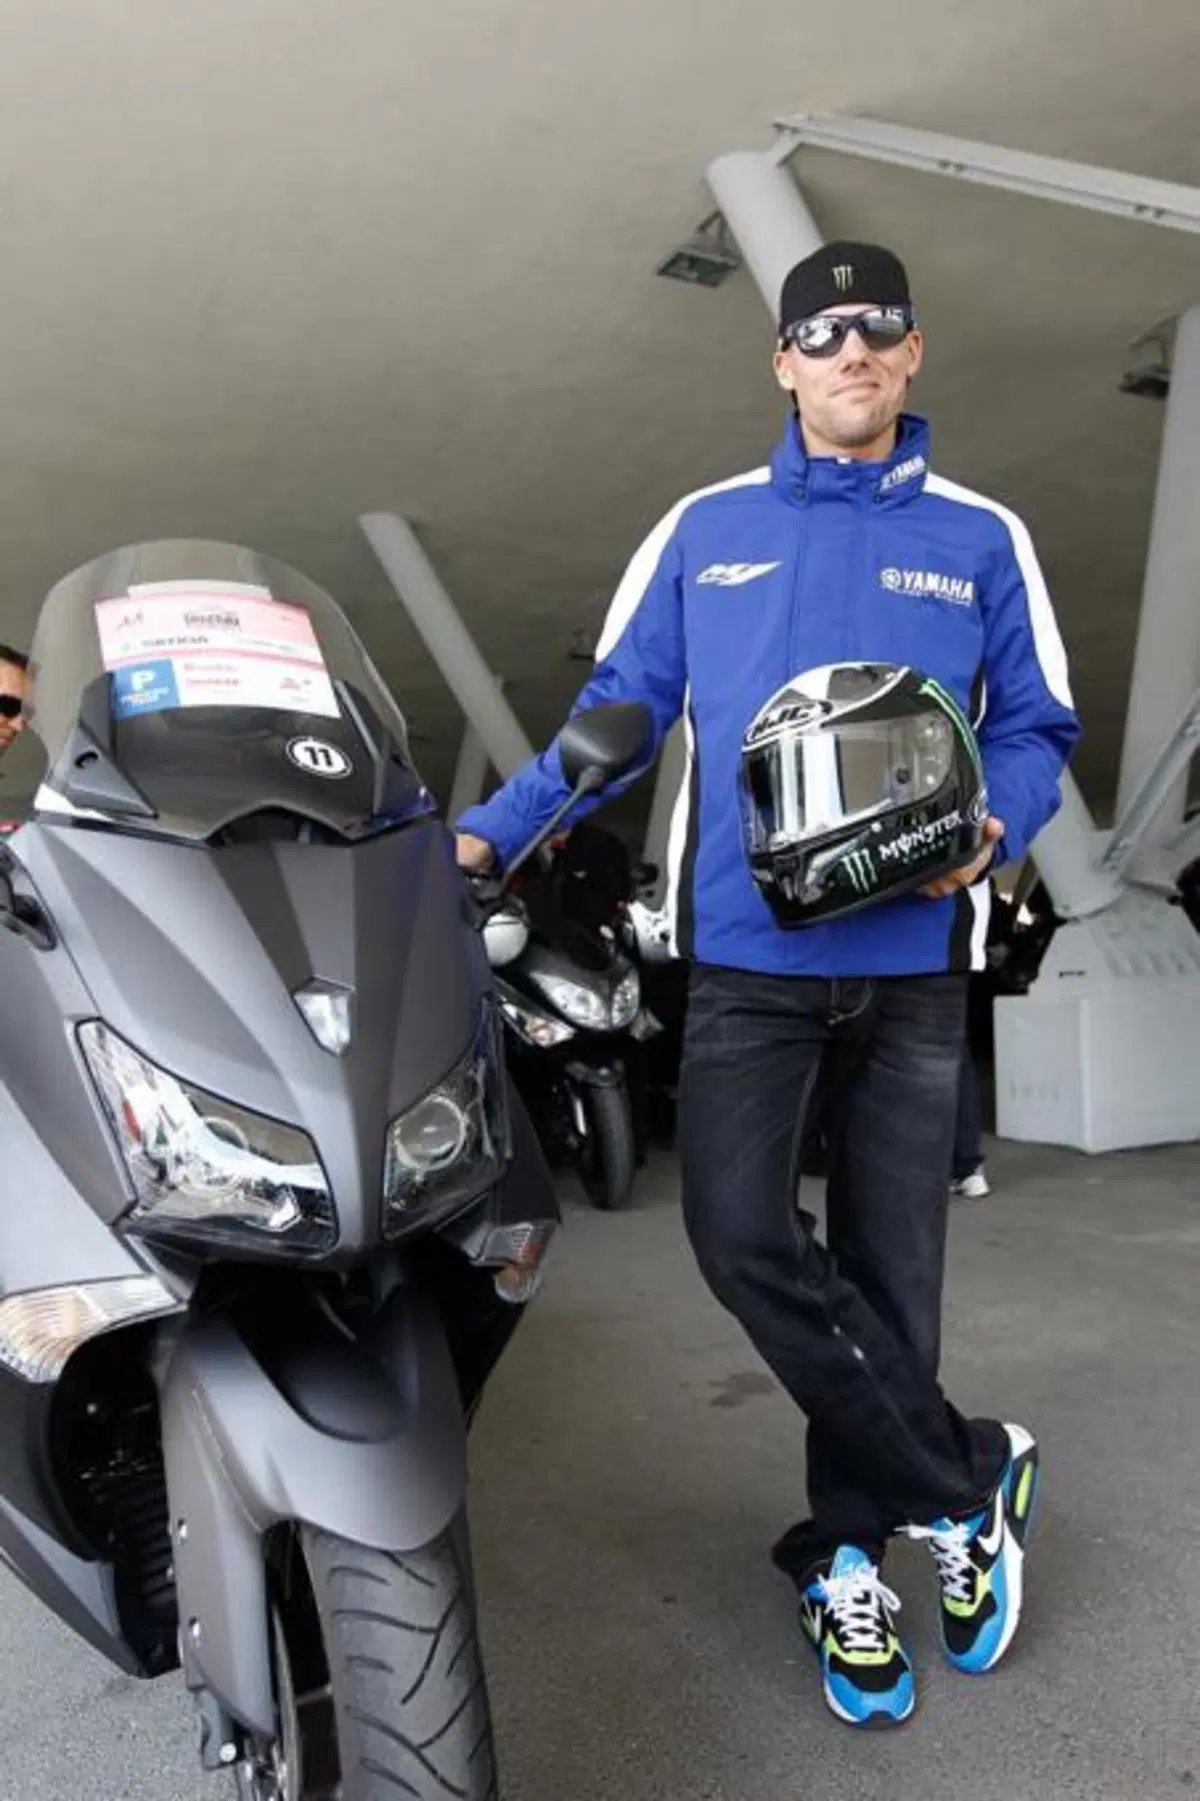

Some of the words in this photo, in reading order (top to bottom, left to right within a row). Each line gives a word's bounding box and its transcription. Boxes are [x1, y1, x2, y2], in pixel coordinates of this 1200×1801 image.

[902, 570, 974, 602] YAMAHA
[304, 746, 333, 767] 11
[878, 810, 963, 861] MONSTER
